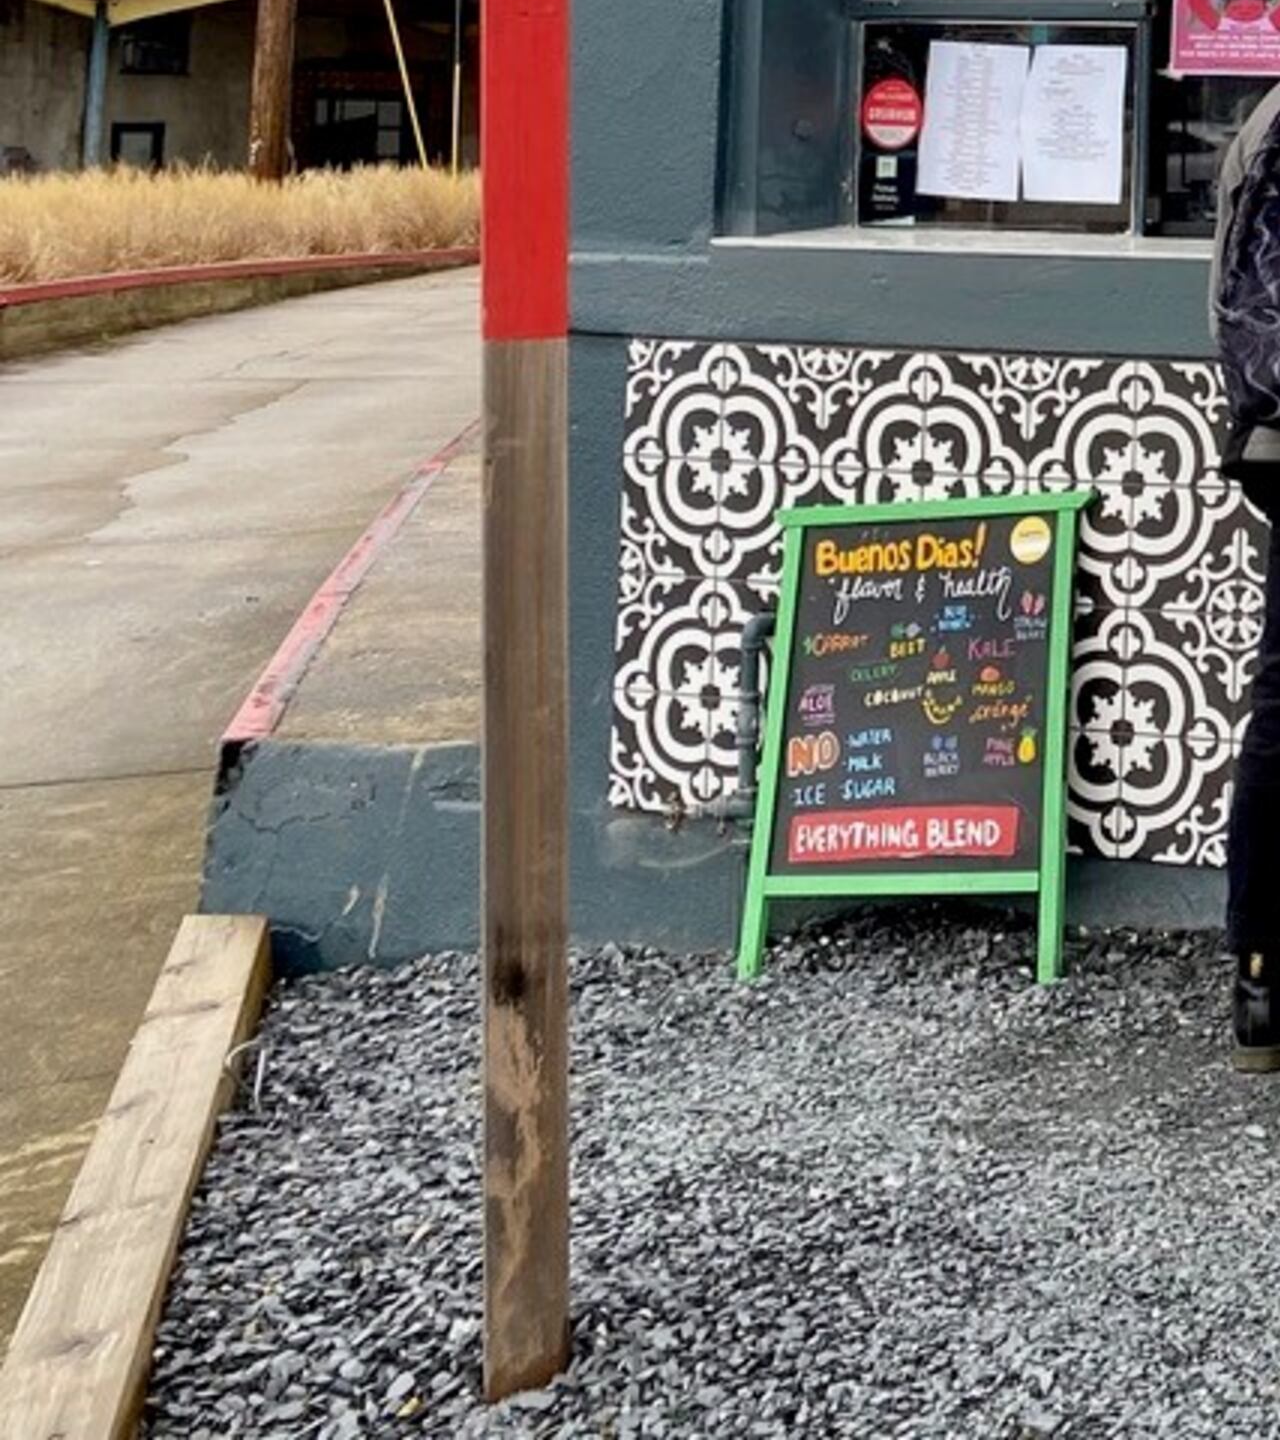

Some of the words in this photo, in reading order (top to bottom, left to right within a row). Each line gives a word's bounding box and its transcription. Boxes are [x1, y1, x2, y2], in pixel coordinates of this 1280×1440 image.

[814, 537, 913, 577] Buenos
[785, 730, 841, 778] NO
[794, 820, 920, 854] EVERYTHING
[925, 818, 1002, 850] BLEND
